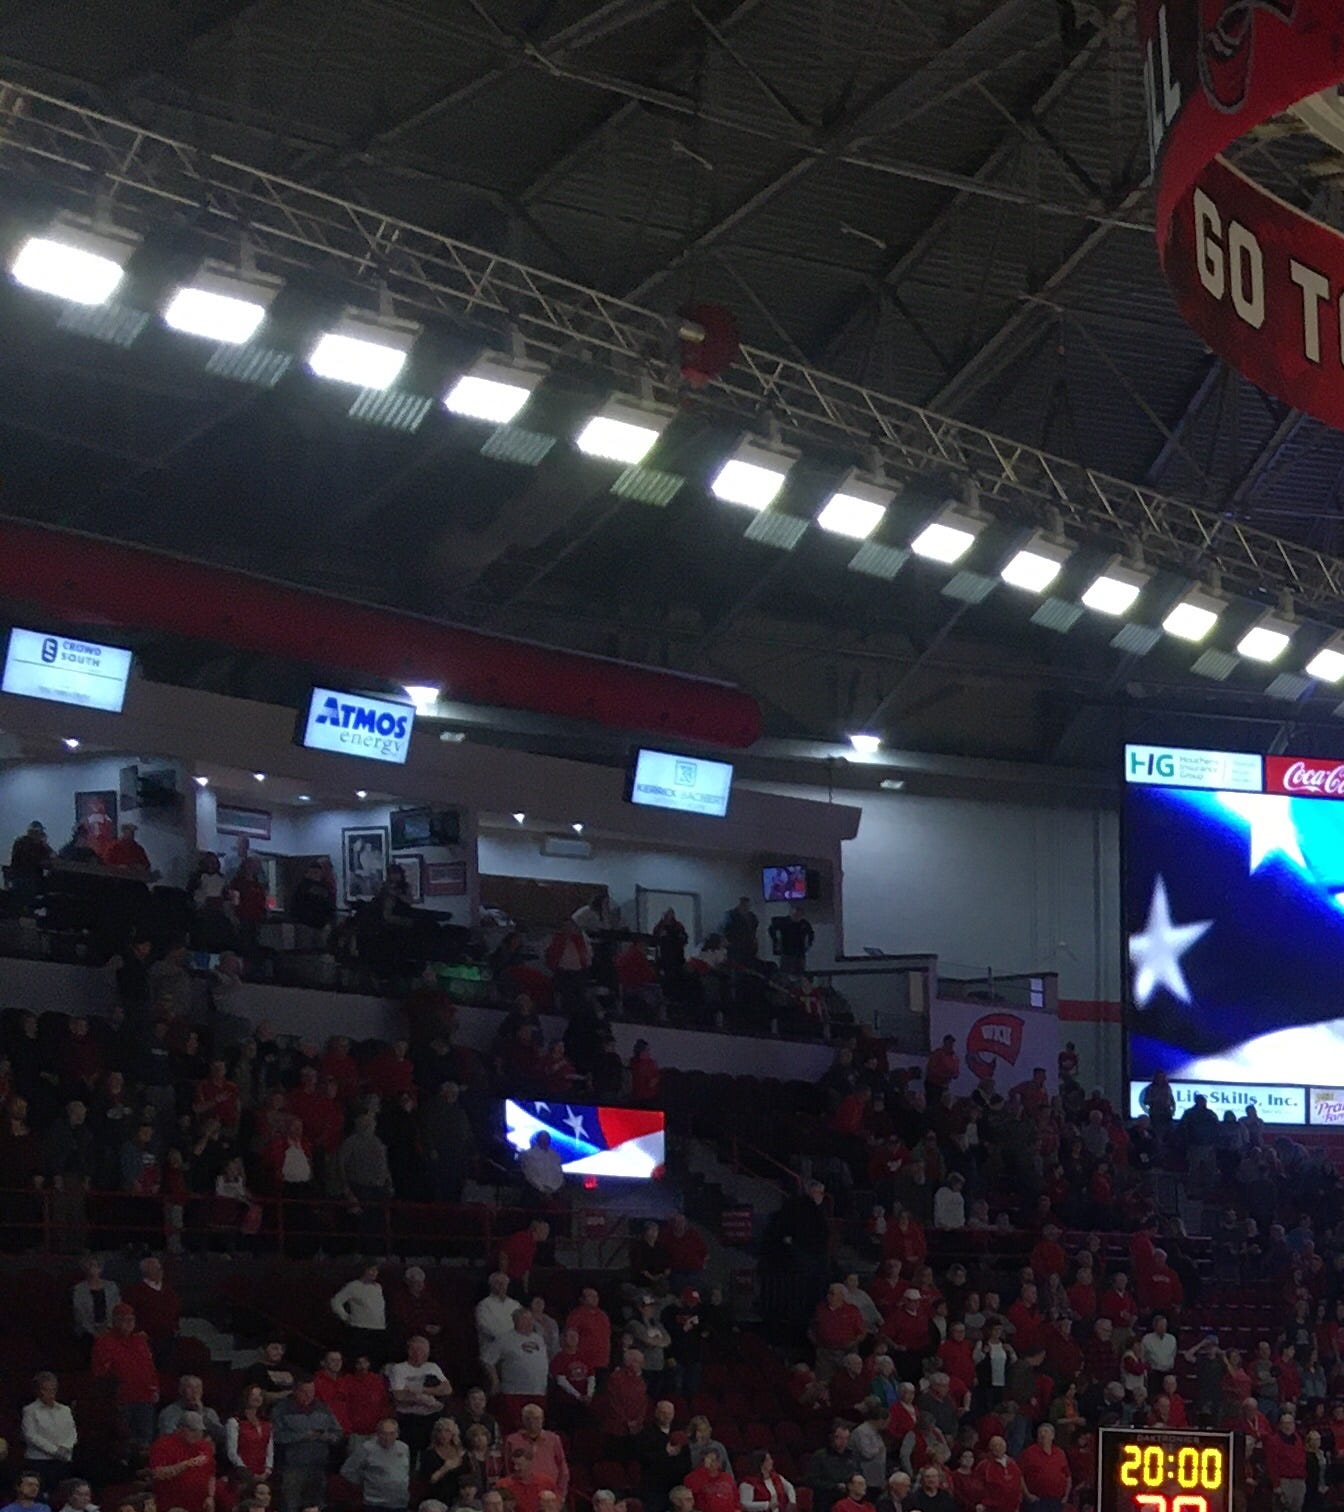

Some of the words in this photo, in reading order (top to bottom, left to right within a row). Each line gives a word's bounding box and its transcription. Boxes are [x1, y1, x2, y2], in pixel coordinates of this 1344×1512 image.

[1193, 187, 1265, 330] GO
[316, 697, 408, 738] ATMOS
[339, 729, 403, 755] energy
[1120, 1444, 1223, 1490] 20:00
